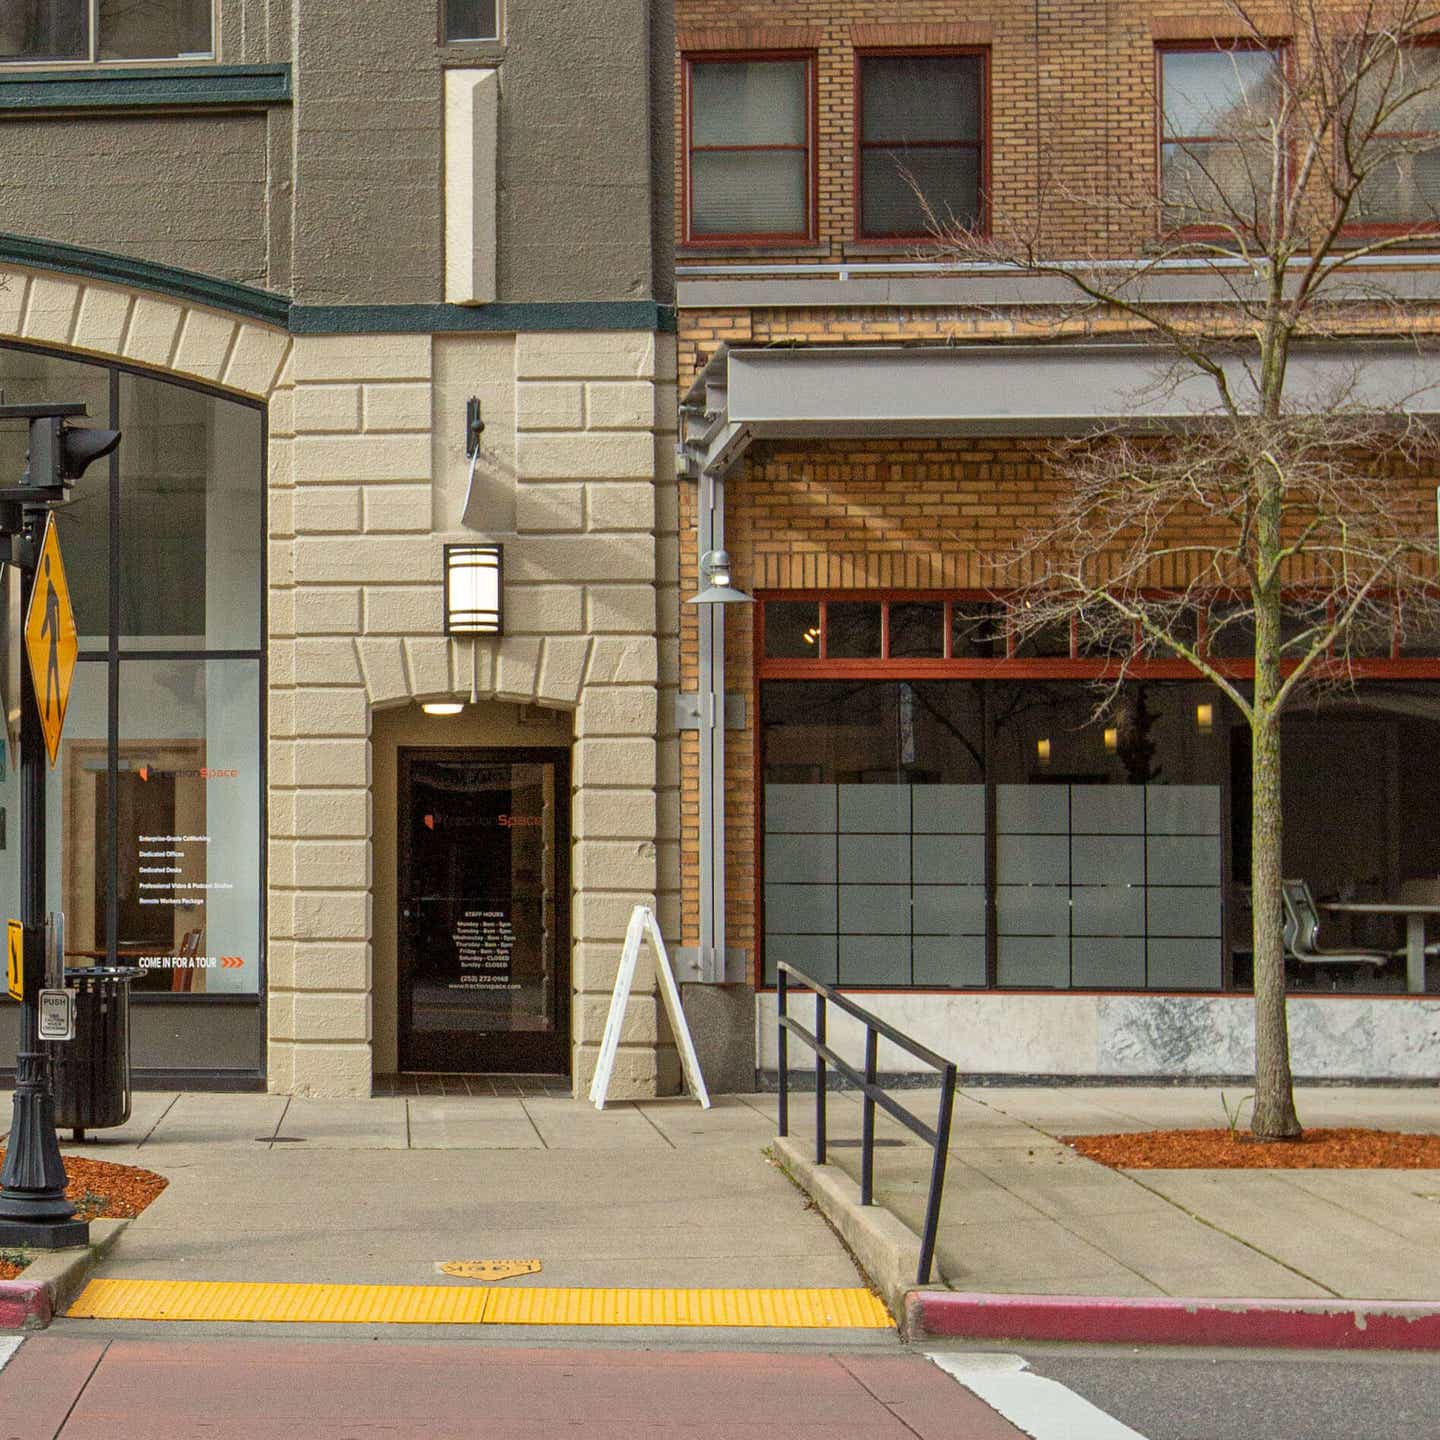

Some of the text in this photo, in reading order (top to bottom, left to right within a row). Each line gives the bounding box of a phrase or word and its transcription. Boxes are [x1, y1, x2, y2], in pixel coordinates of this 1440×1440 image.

[138, 957, 217, 968] COME IN FOR A TOUR
